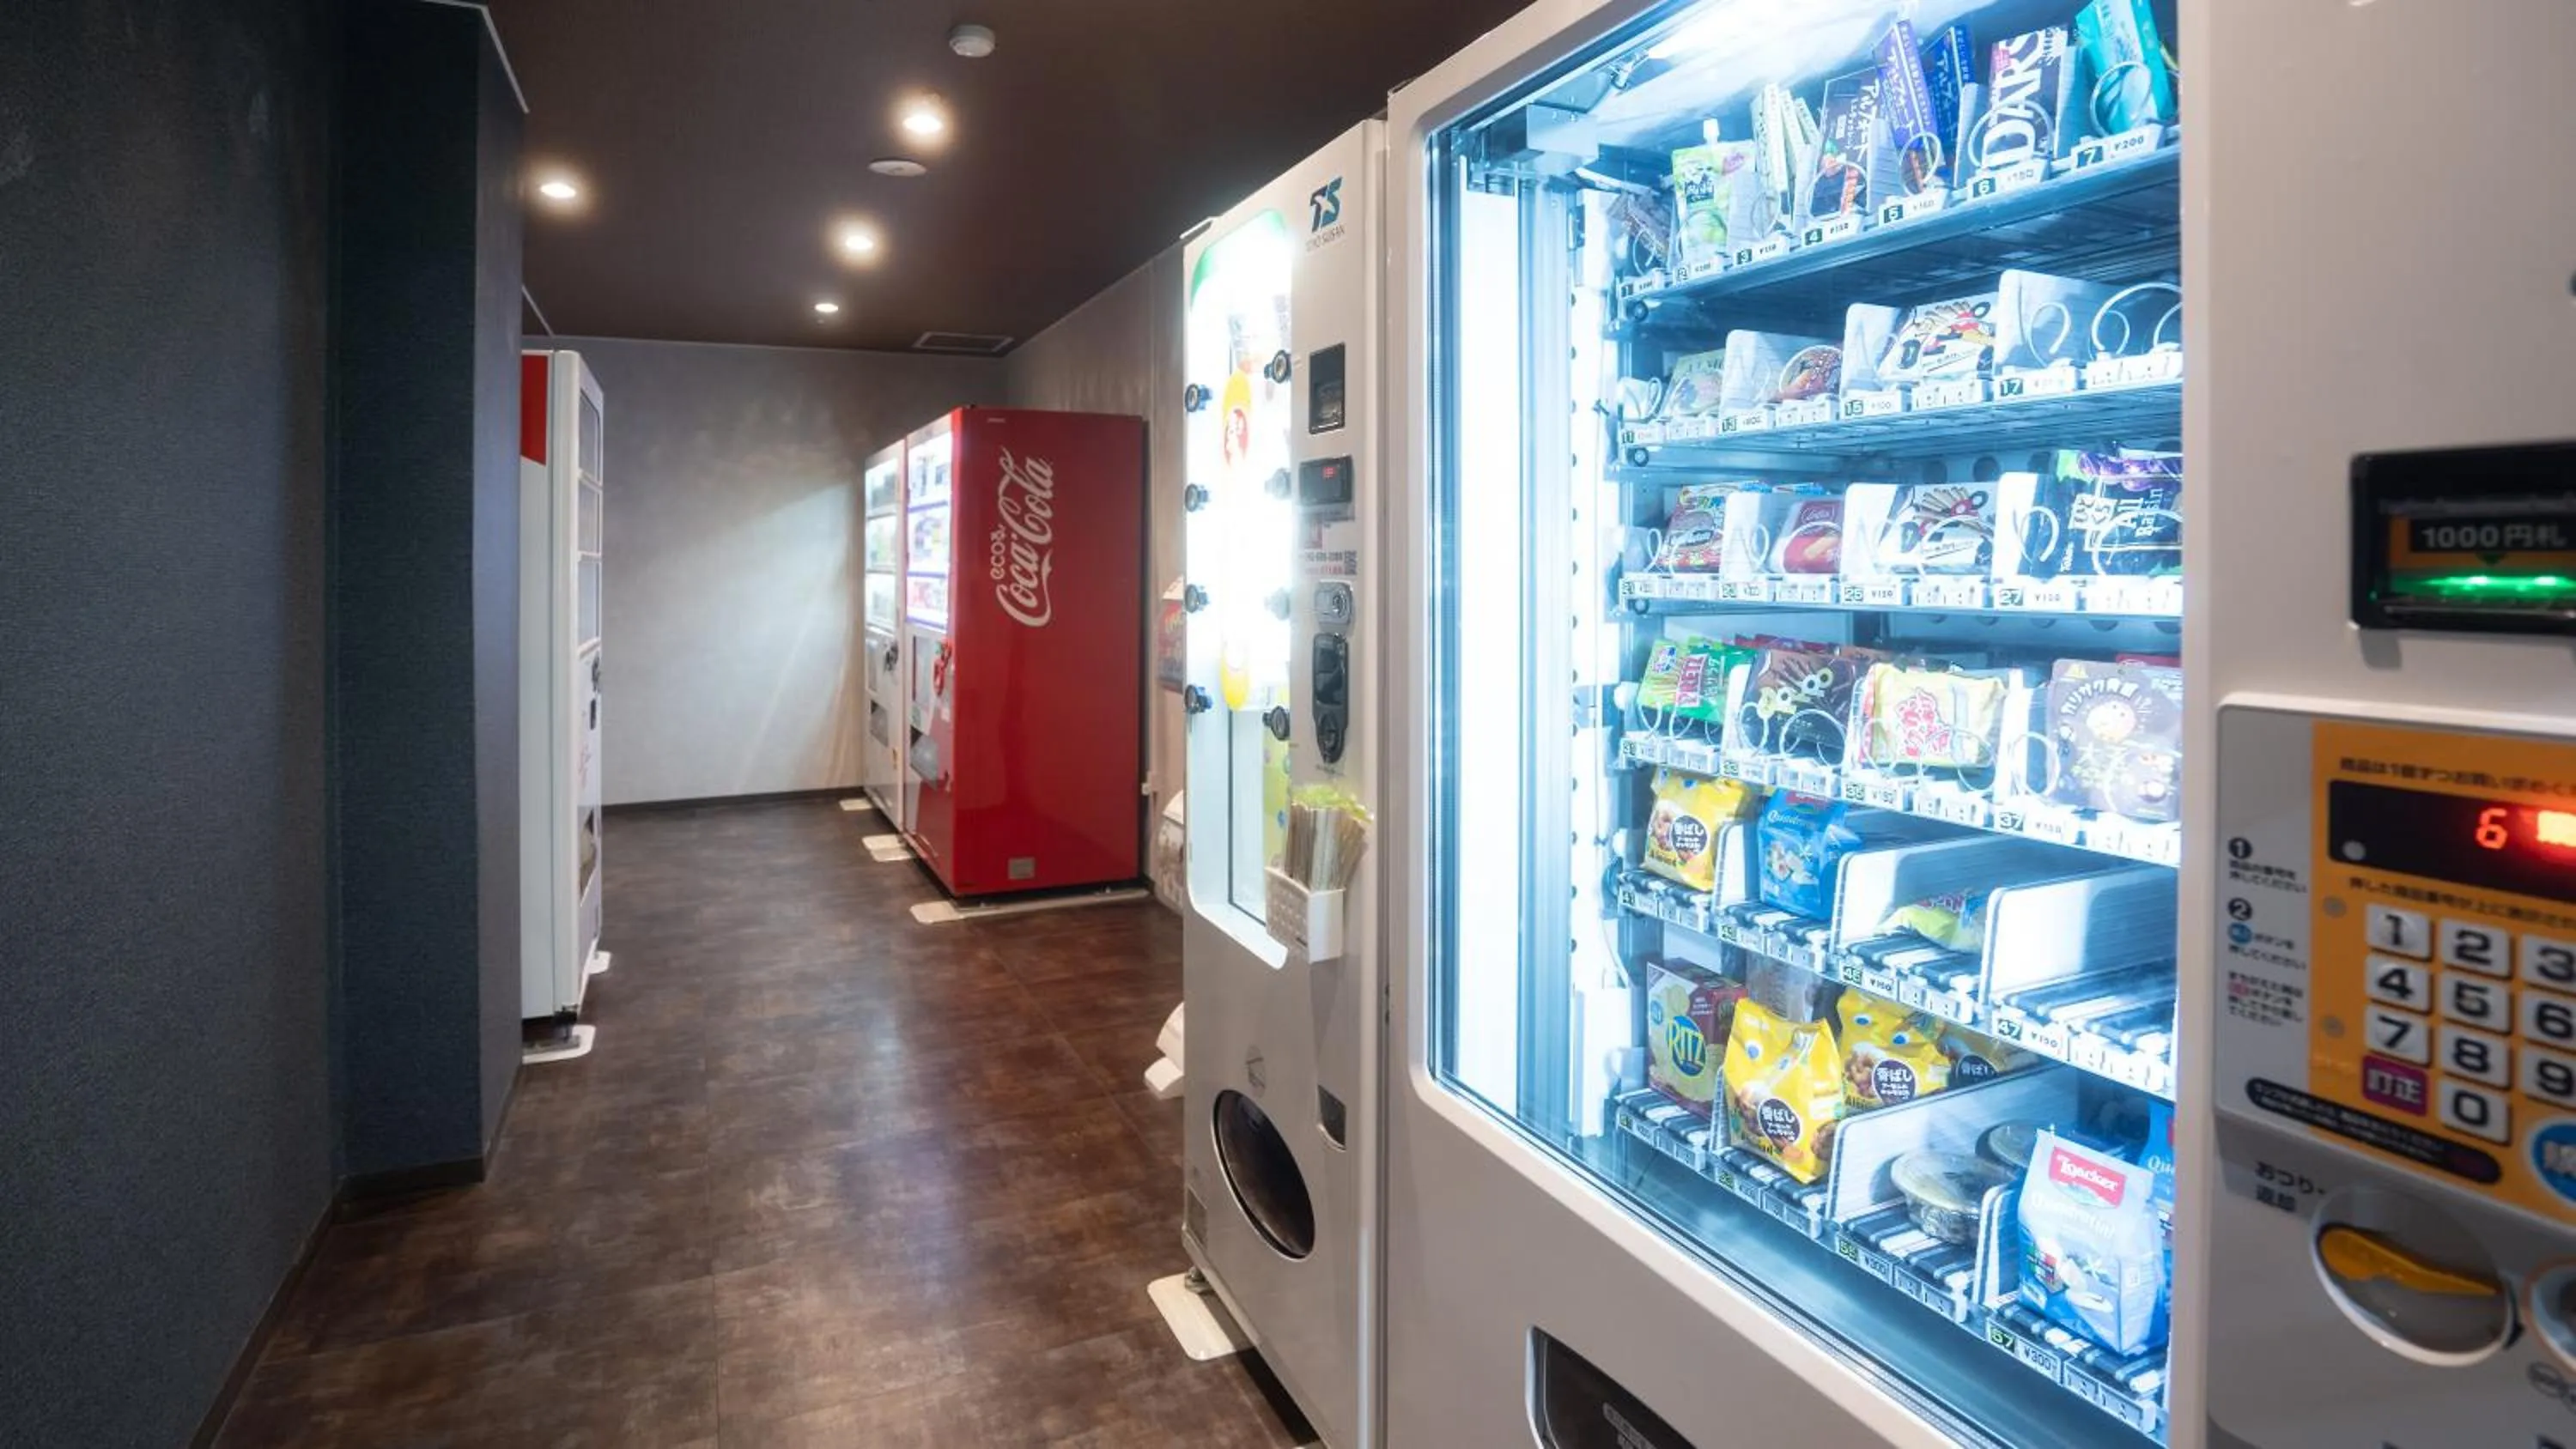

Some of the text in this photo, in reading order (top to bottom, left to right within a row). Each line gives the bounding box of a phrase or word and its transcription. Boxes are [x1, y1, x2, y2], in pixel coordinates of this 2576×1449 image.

[1982, 31, 2041, 168] DARS
[2001, 378, 2023, 397] 17
[1844, 400, 1864, 416] 15
[2421, 524, 2567, 549] 1000円札
[1844, 586, 1864, 603] 25
[2000, 589, 2024, 607] 27
[2000, 811, 2024, 832] 37
[2475, 808, 2508, 851] 6
[2382, 913, 2575, 984] 1 2 3
[2378, 968, 2573, 1039] 4 5 6
[1668, 1018, 1704, 1068] RITZ
[1998, 1019, 2022, 1040] 47
[2378, 1015, 2573, 1097] 7 8 9
[2367, 1068, 2422, 1104] 訂正
[2453, 1090, 2488, 1126] 0
[1991, 1331, 2014, 1353] 57
